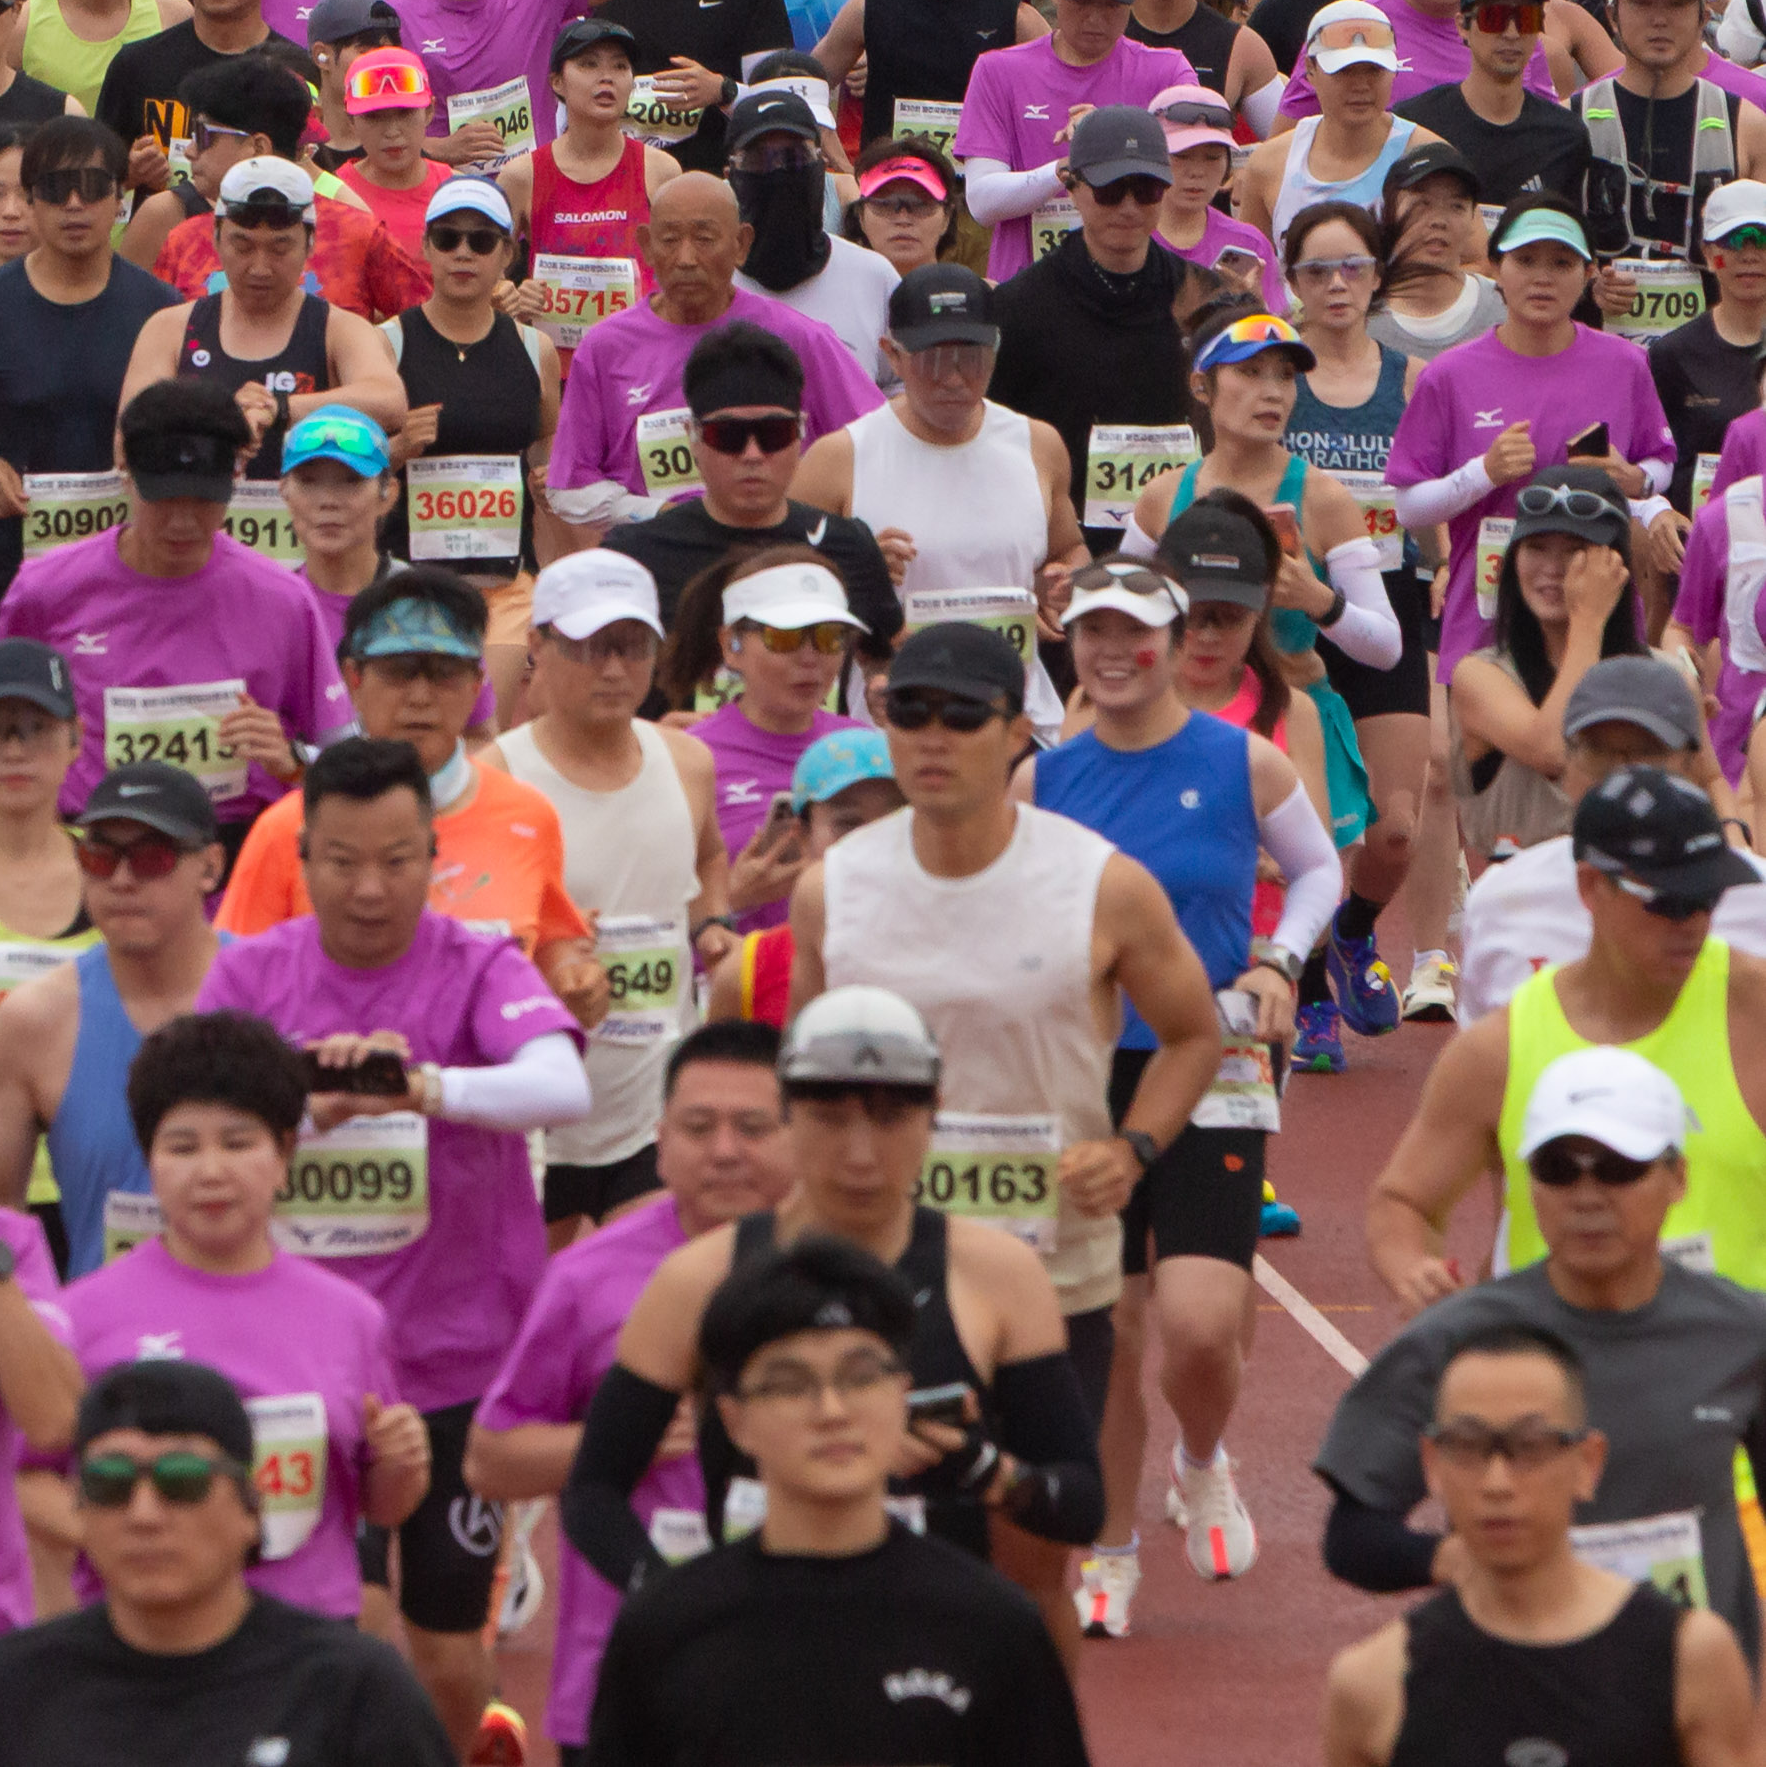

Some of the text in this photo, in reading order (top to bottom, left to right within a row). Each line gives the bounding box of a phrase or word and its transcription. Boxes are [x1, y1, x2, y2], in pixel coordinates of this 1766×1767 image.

[554, 210, 627, 224] SALOMON
[32, 500, 130, 541] 30902
[415, 489, 516, 522] 36026
